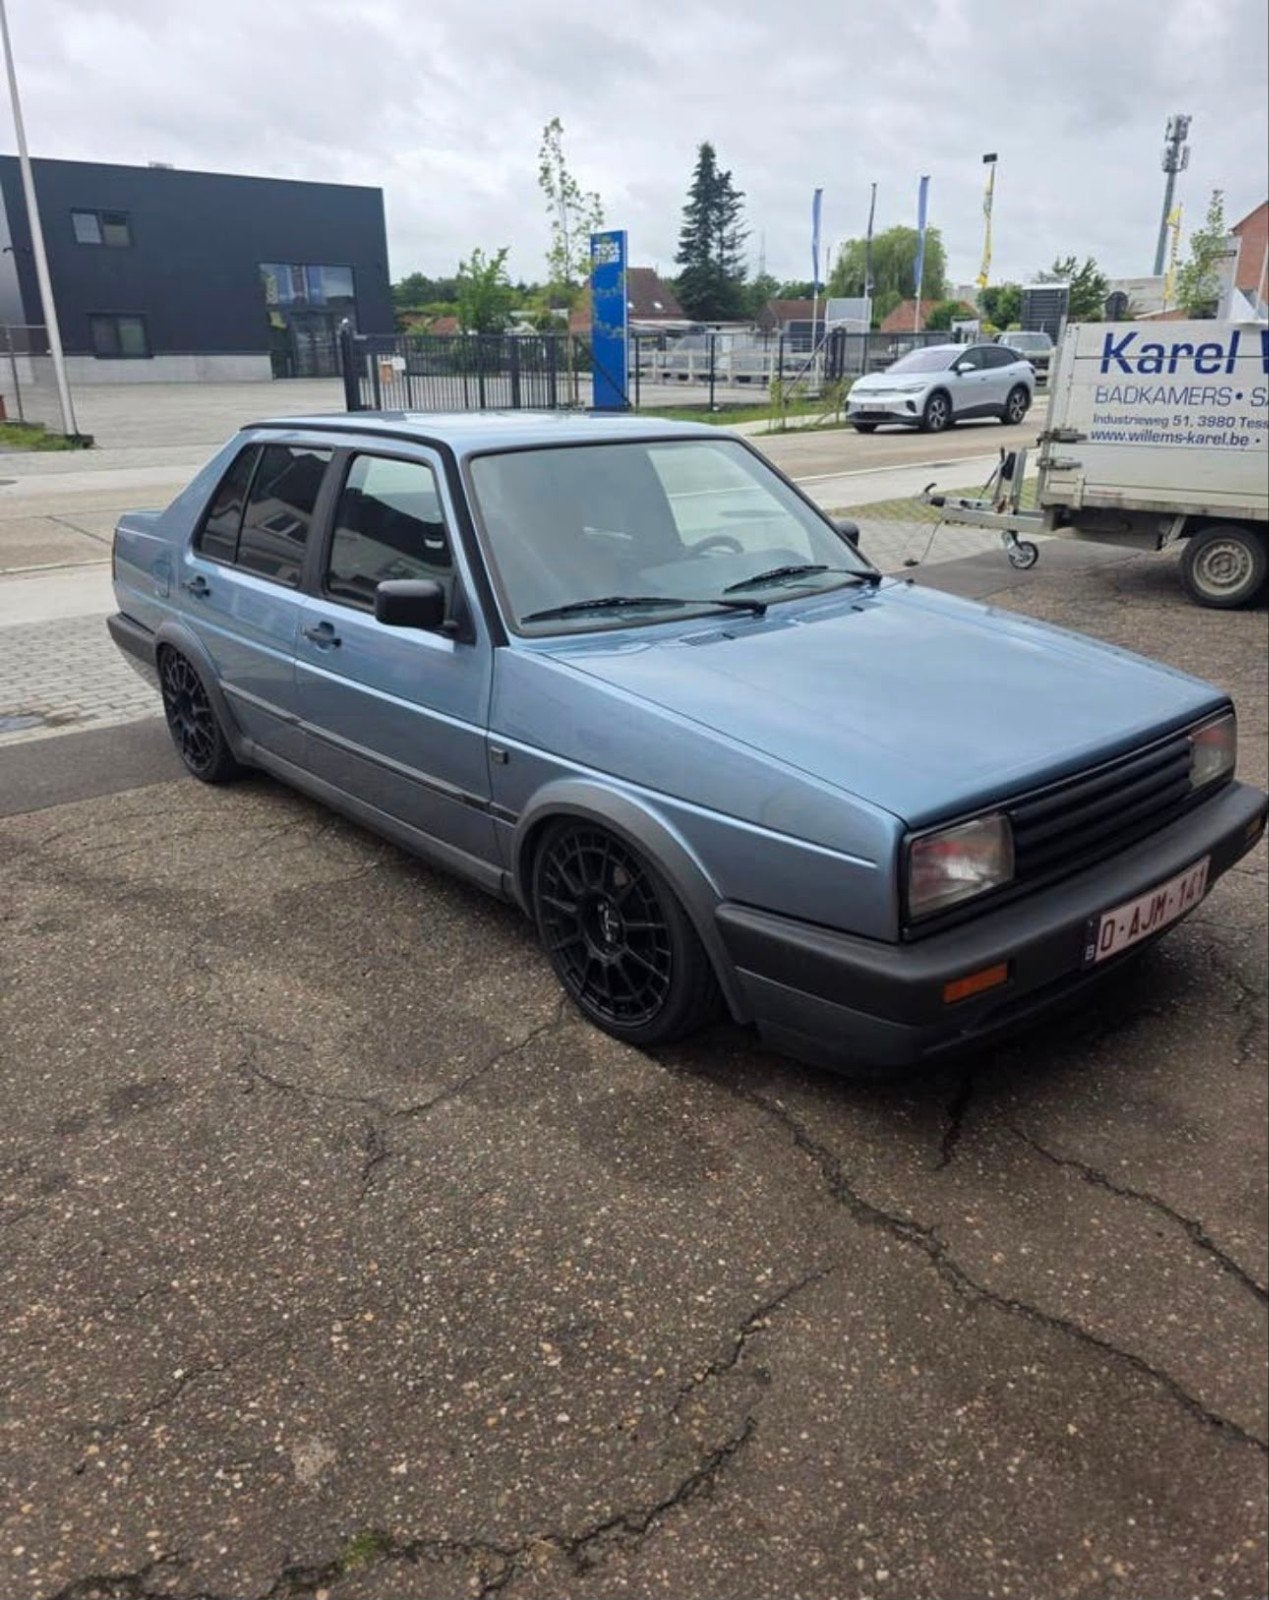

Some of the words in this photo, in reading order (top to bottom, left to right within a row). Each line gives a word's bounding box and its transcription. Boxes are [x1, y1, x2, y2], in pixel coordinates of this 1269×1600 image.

[1100, 330, 1241, 374] Karel
[1094, 385, 1233, 407] BADKAMERS
[1093, 412, 1169, 429] Industrieweg
[1090, 429, 1250, 446] www.willems-karel.be
